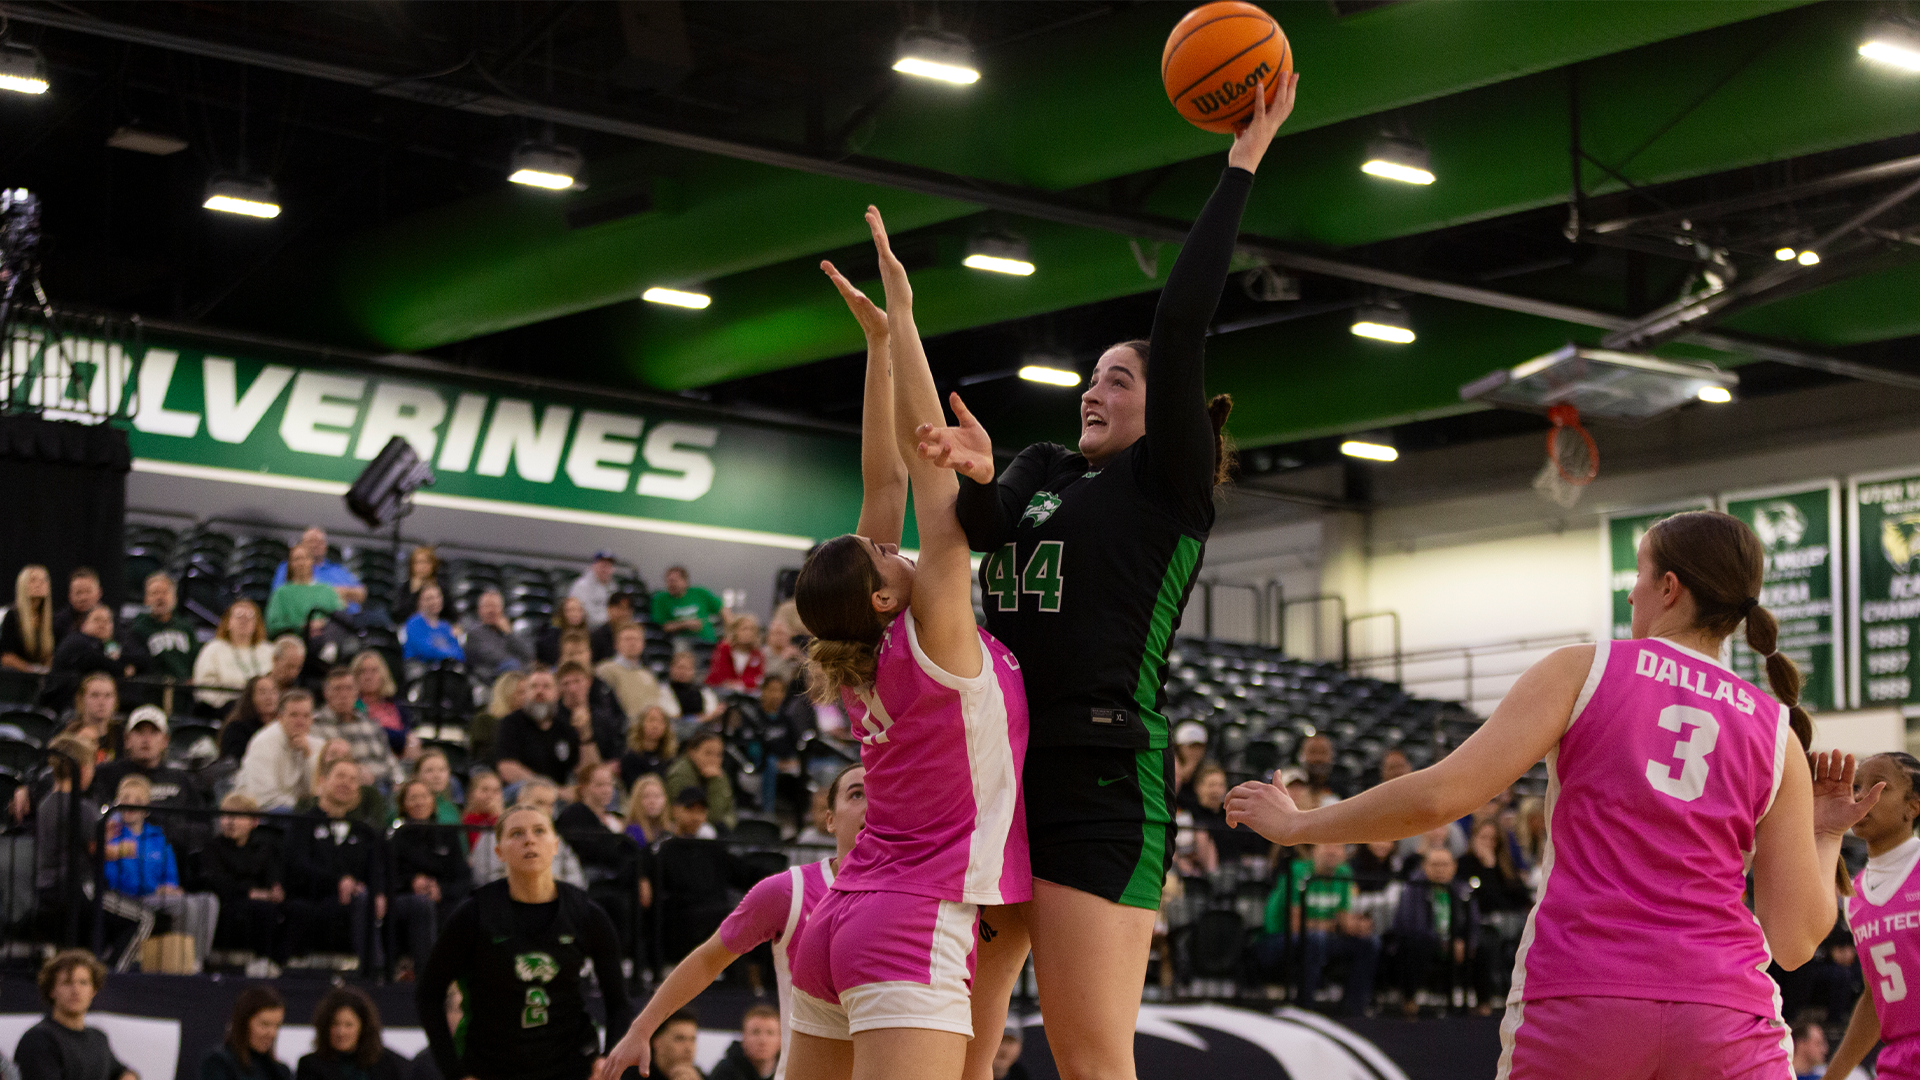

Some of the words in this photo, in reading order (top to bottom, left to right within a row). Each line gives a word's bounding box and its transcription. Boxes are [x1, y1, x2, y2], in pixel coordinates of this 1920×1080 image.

[1190, 61, 1271, 115] Wilson
[985, 540, 1064, 613] 44
[1635, 648, 1756, 716] DALLAS
[1116, 713, 1124, 722] XL
[1645, 704, 1720, 802] 3
[1883, 911, 1920, 933] TEC
[1870, 941, 1908, 1004] 5
[521, 987, 550, 1029] 2
